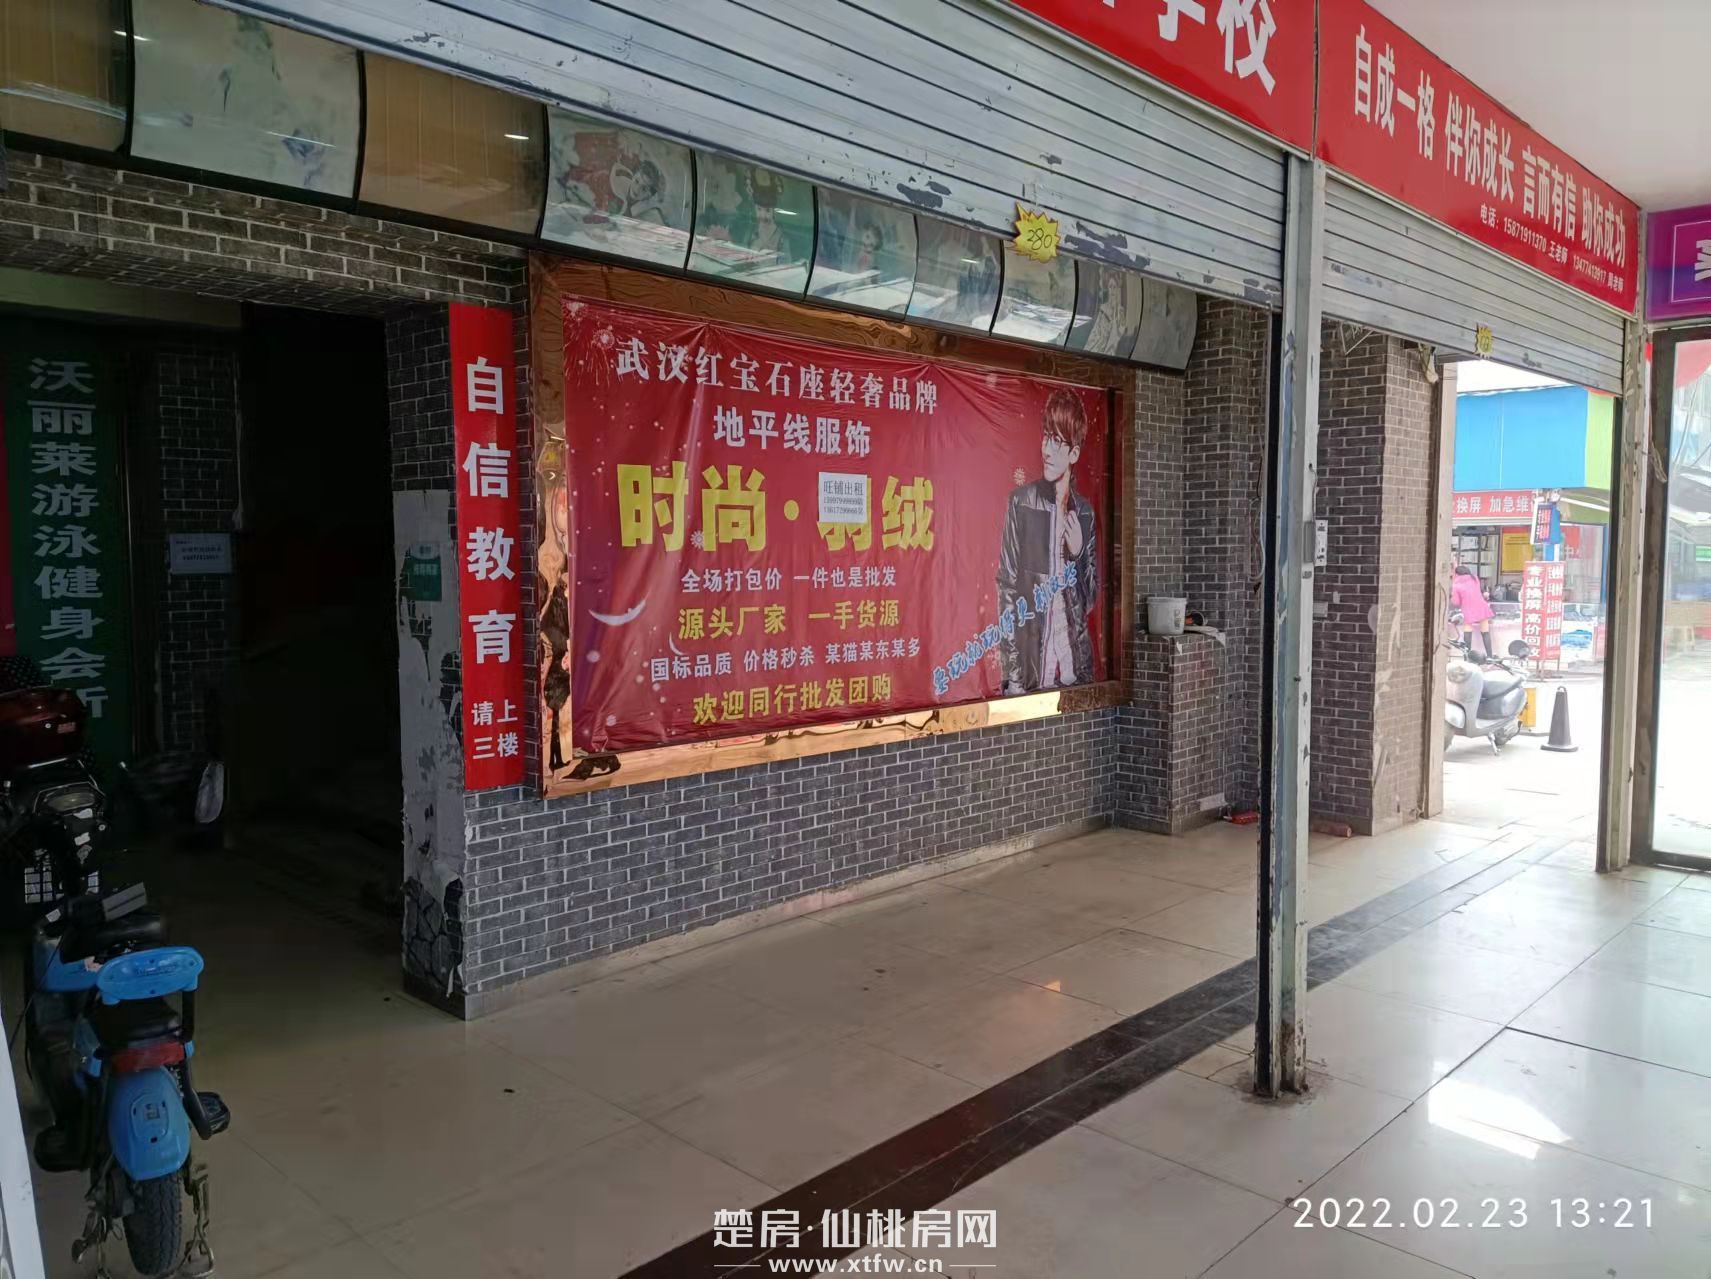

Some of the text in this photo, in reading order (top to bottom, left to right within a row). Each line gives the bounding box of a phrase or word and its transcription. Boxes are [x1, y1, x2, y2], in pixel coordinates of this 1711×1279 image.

[1354, 23, 1626, 268] 自成一格 伴你成长 言而有信 助你成功
[1026, 227, 1053, 250] 280
[615, 337, 938, 415] 武汉红宝石座轻奢品牌
[713, 405, 871, 458] 地平线服饰
[462, 355, 517, 665] 自信教育
[1489, 495, 1534, 513] 加急维
[680, 566, 898, 594] 全场打包价 一件也是批发
[678, 599, 900, 640] 源头厂家 一手货源
[650, 637, 921, 683] 国标品质 价格秒杀 某猫某东某多
[471, 699, 518, 727] 请上
[692, 672, 892, 725] 欢迎同行批发团购
[472, 731, 519, 760] 三楼
